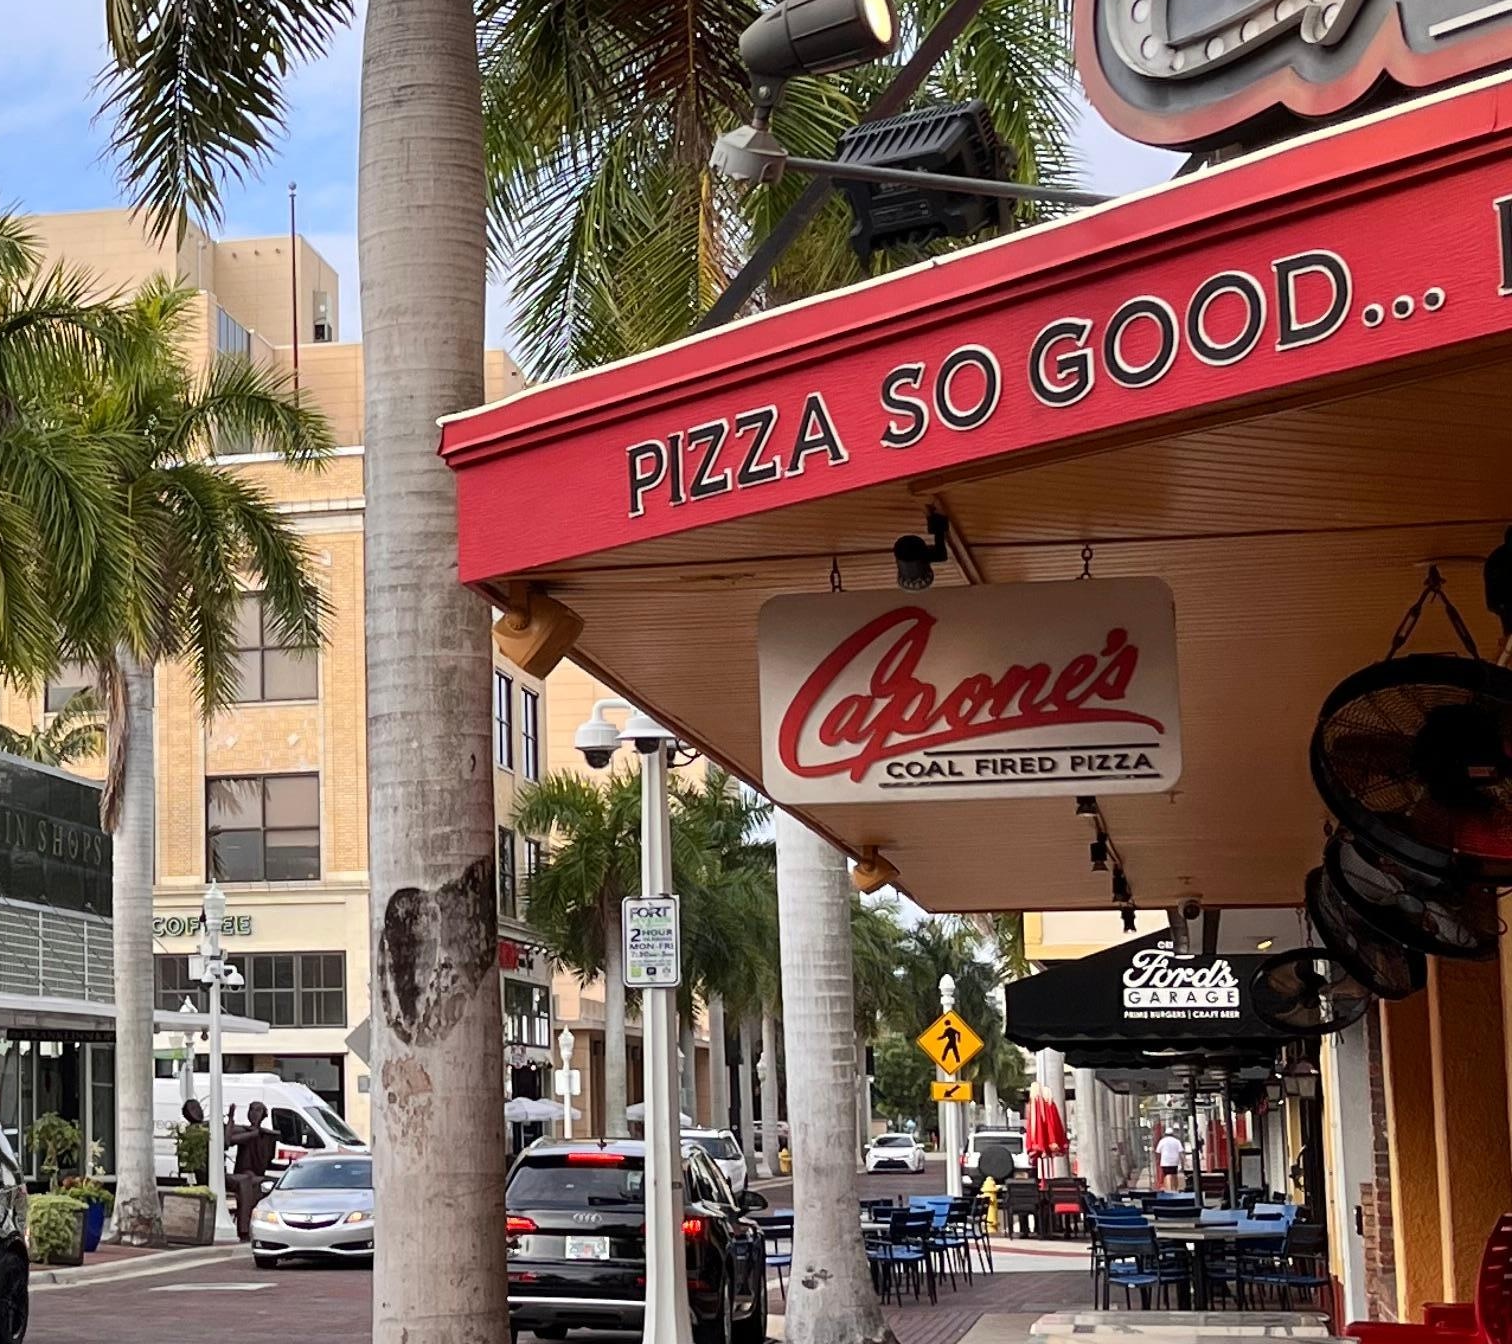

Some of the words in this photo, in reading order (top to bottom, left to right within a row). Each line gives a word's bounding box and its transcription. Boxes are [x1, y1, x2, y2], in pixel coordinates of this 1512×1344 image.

[626, 391, 849, 518] PIZZA
[881, 344, 1002, 448] SO
[1029, 248, 1446, 409] GOOD...
[778, 606, 1165, 782] Capone's
[887, 760, 962, 779] COAL
[975, 756, 1057, 776] FIRED
[1070, 753, 1153, 772] PIZZA
[38, 819, 103, 866] SHOPS
[152, 915, 252, 937] COFEE
[631, 928, 641, 942] 2
[1122, 949, 1239, 988] Ford's
[1128, 991, 1236, 1004] GARAGE
[1123, 1010, 1148, 1019] PRIME
[1150, 1010, 1187, 1019] BURGERS
[1192, 1010, 1219, 1019] CRAFT
[1220, 1010, 1240, 1019] BEER
